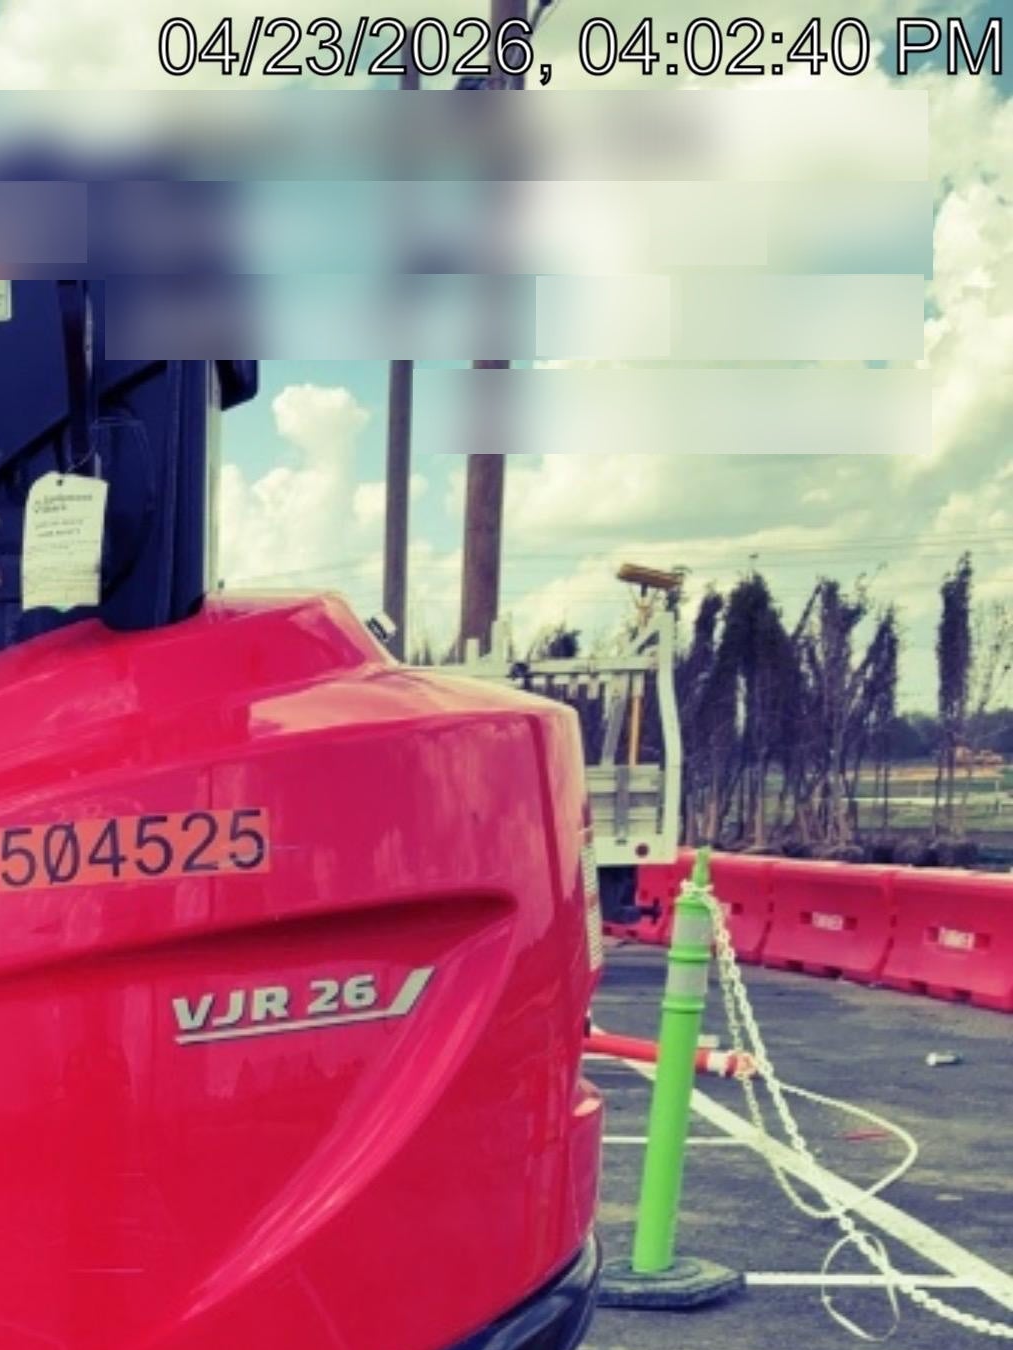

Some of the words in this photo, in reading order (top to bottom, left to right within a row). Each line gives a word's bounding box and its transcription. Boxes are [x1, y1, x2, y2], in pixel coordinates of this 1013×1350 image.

[0, 808, 265, 887] 504525
[172, 985, 290, 1031] VJR
[306, 973, 378, 1015] 26
